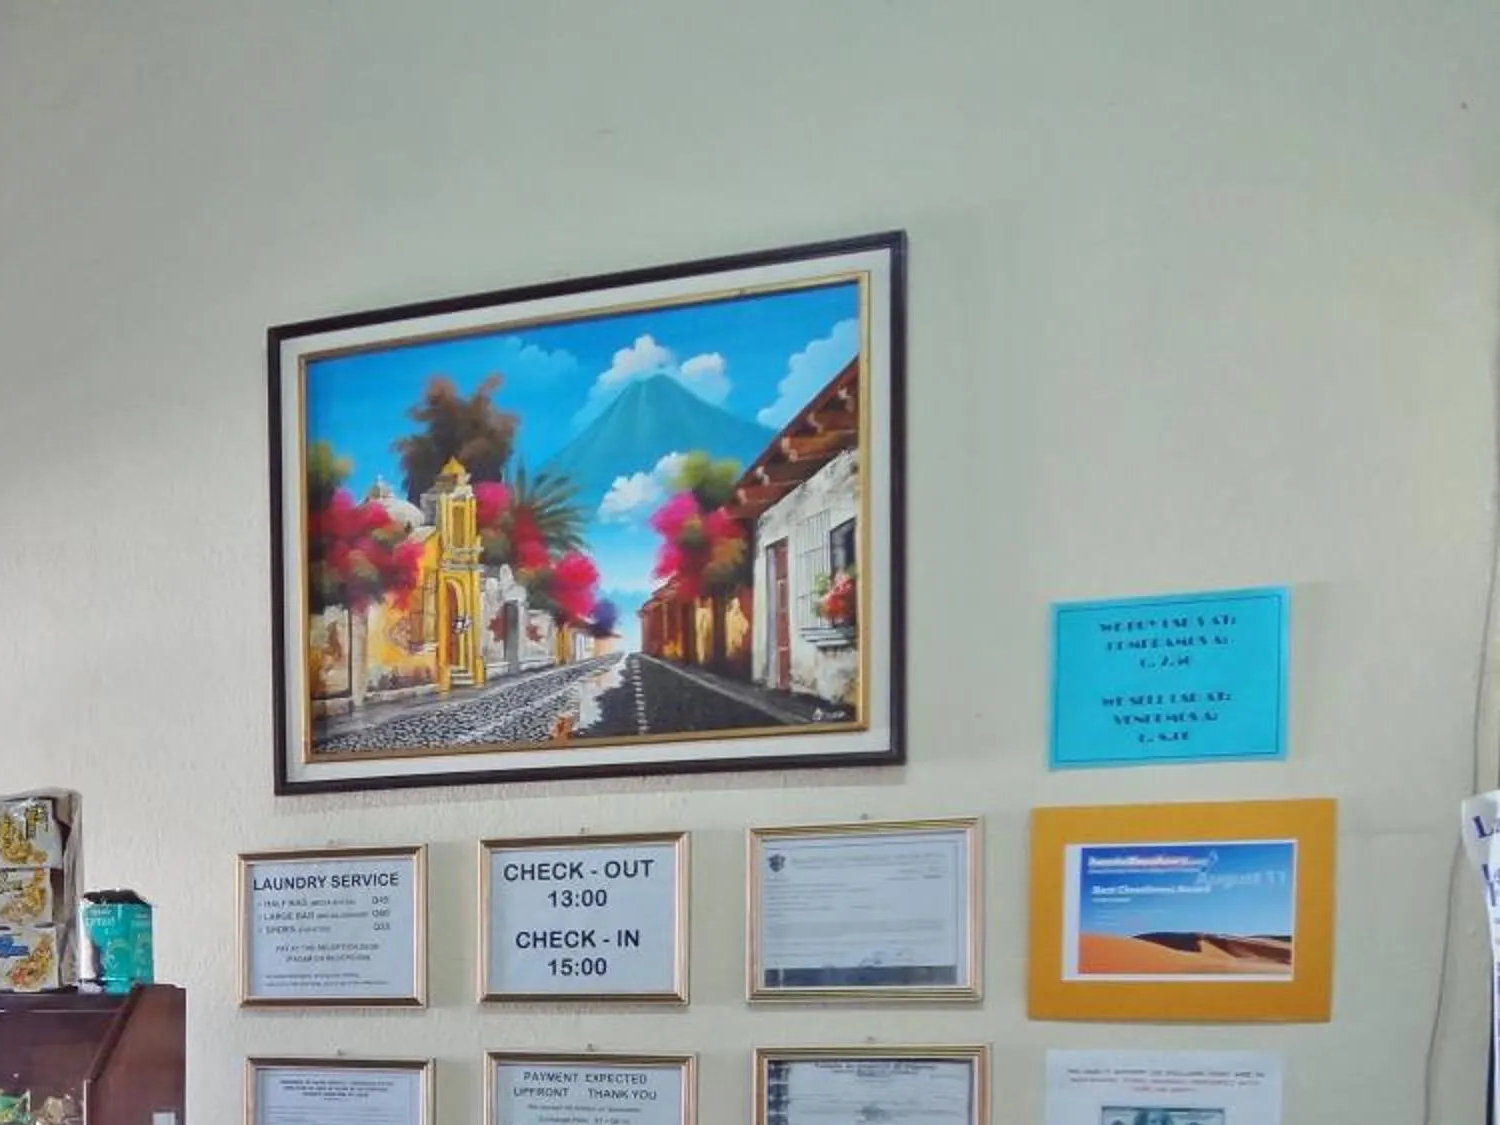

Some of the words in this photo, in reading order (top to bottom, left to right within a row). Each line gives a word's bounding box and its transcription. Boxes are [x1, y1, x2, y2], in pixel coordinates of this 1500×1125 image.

[503, 861, 584, 882] CHECK
[604, 859, 655, 879] OUT
[253, 874, 326, 891] LAUNDRY
[331, 871, 399, 888] SERVICE
[548, 889, 608, 908] 13:00
[515, 930, 596, 949] CHECK
[617, 929, 640, 948] IN
[548, 957, 608, 976] 15:00
[523, 1071, 578, 1084] PAYMENT
[585, 1073, 648, 1085] EXPECTED
[513, 1087, 570, 1098] UPFRONT
[587, 1087, 629, 1099] THANK
[631, 1089, 657, 1101] YOU
